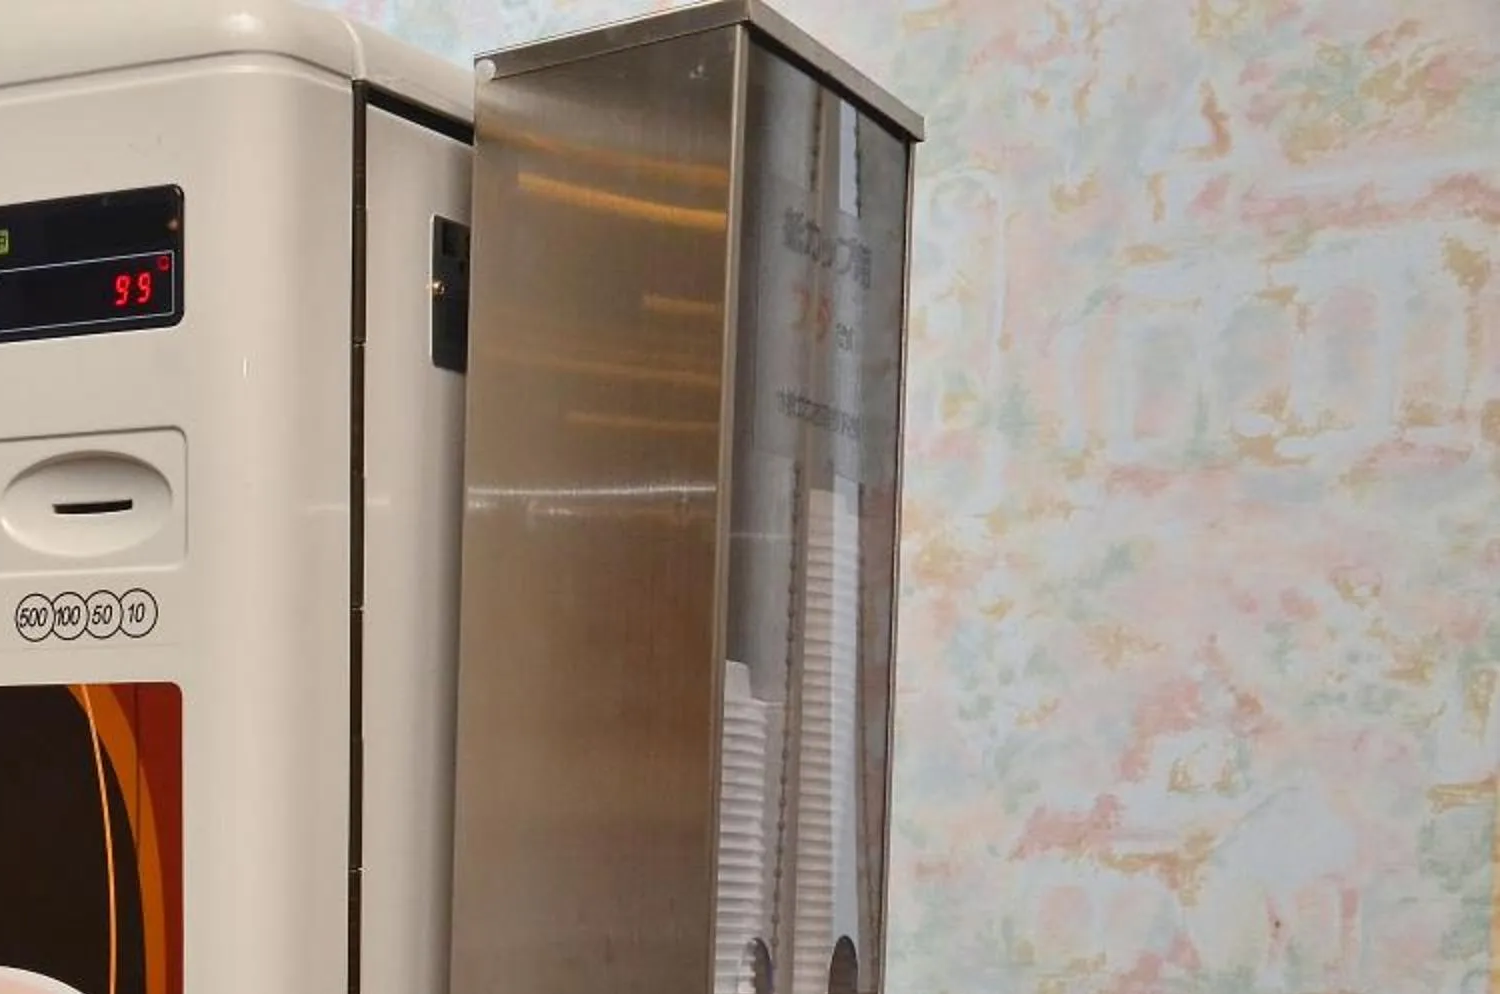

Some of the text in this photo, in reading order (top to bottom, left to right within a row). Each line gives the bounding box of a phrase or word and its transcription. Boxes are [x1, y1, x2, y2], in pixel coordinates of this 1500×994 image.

[19, 602, 146, 628] 500 100 50 10
